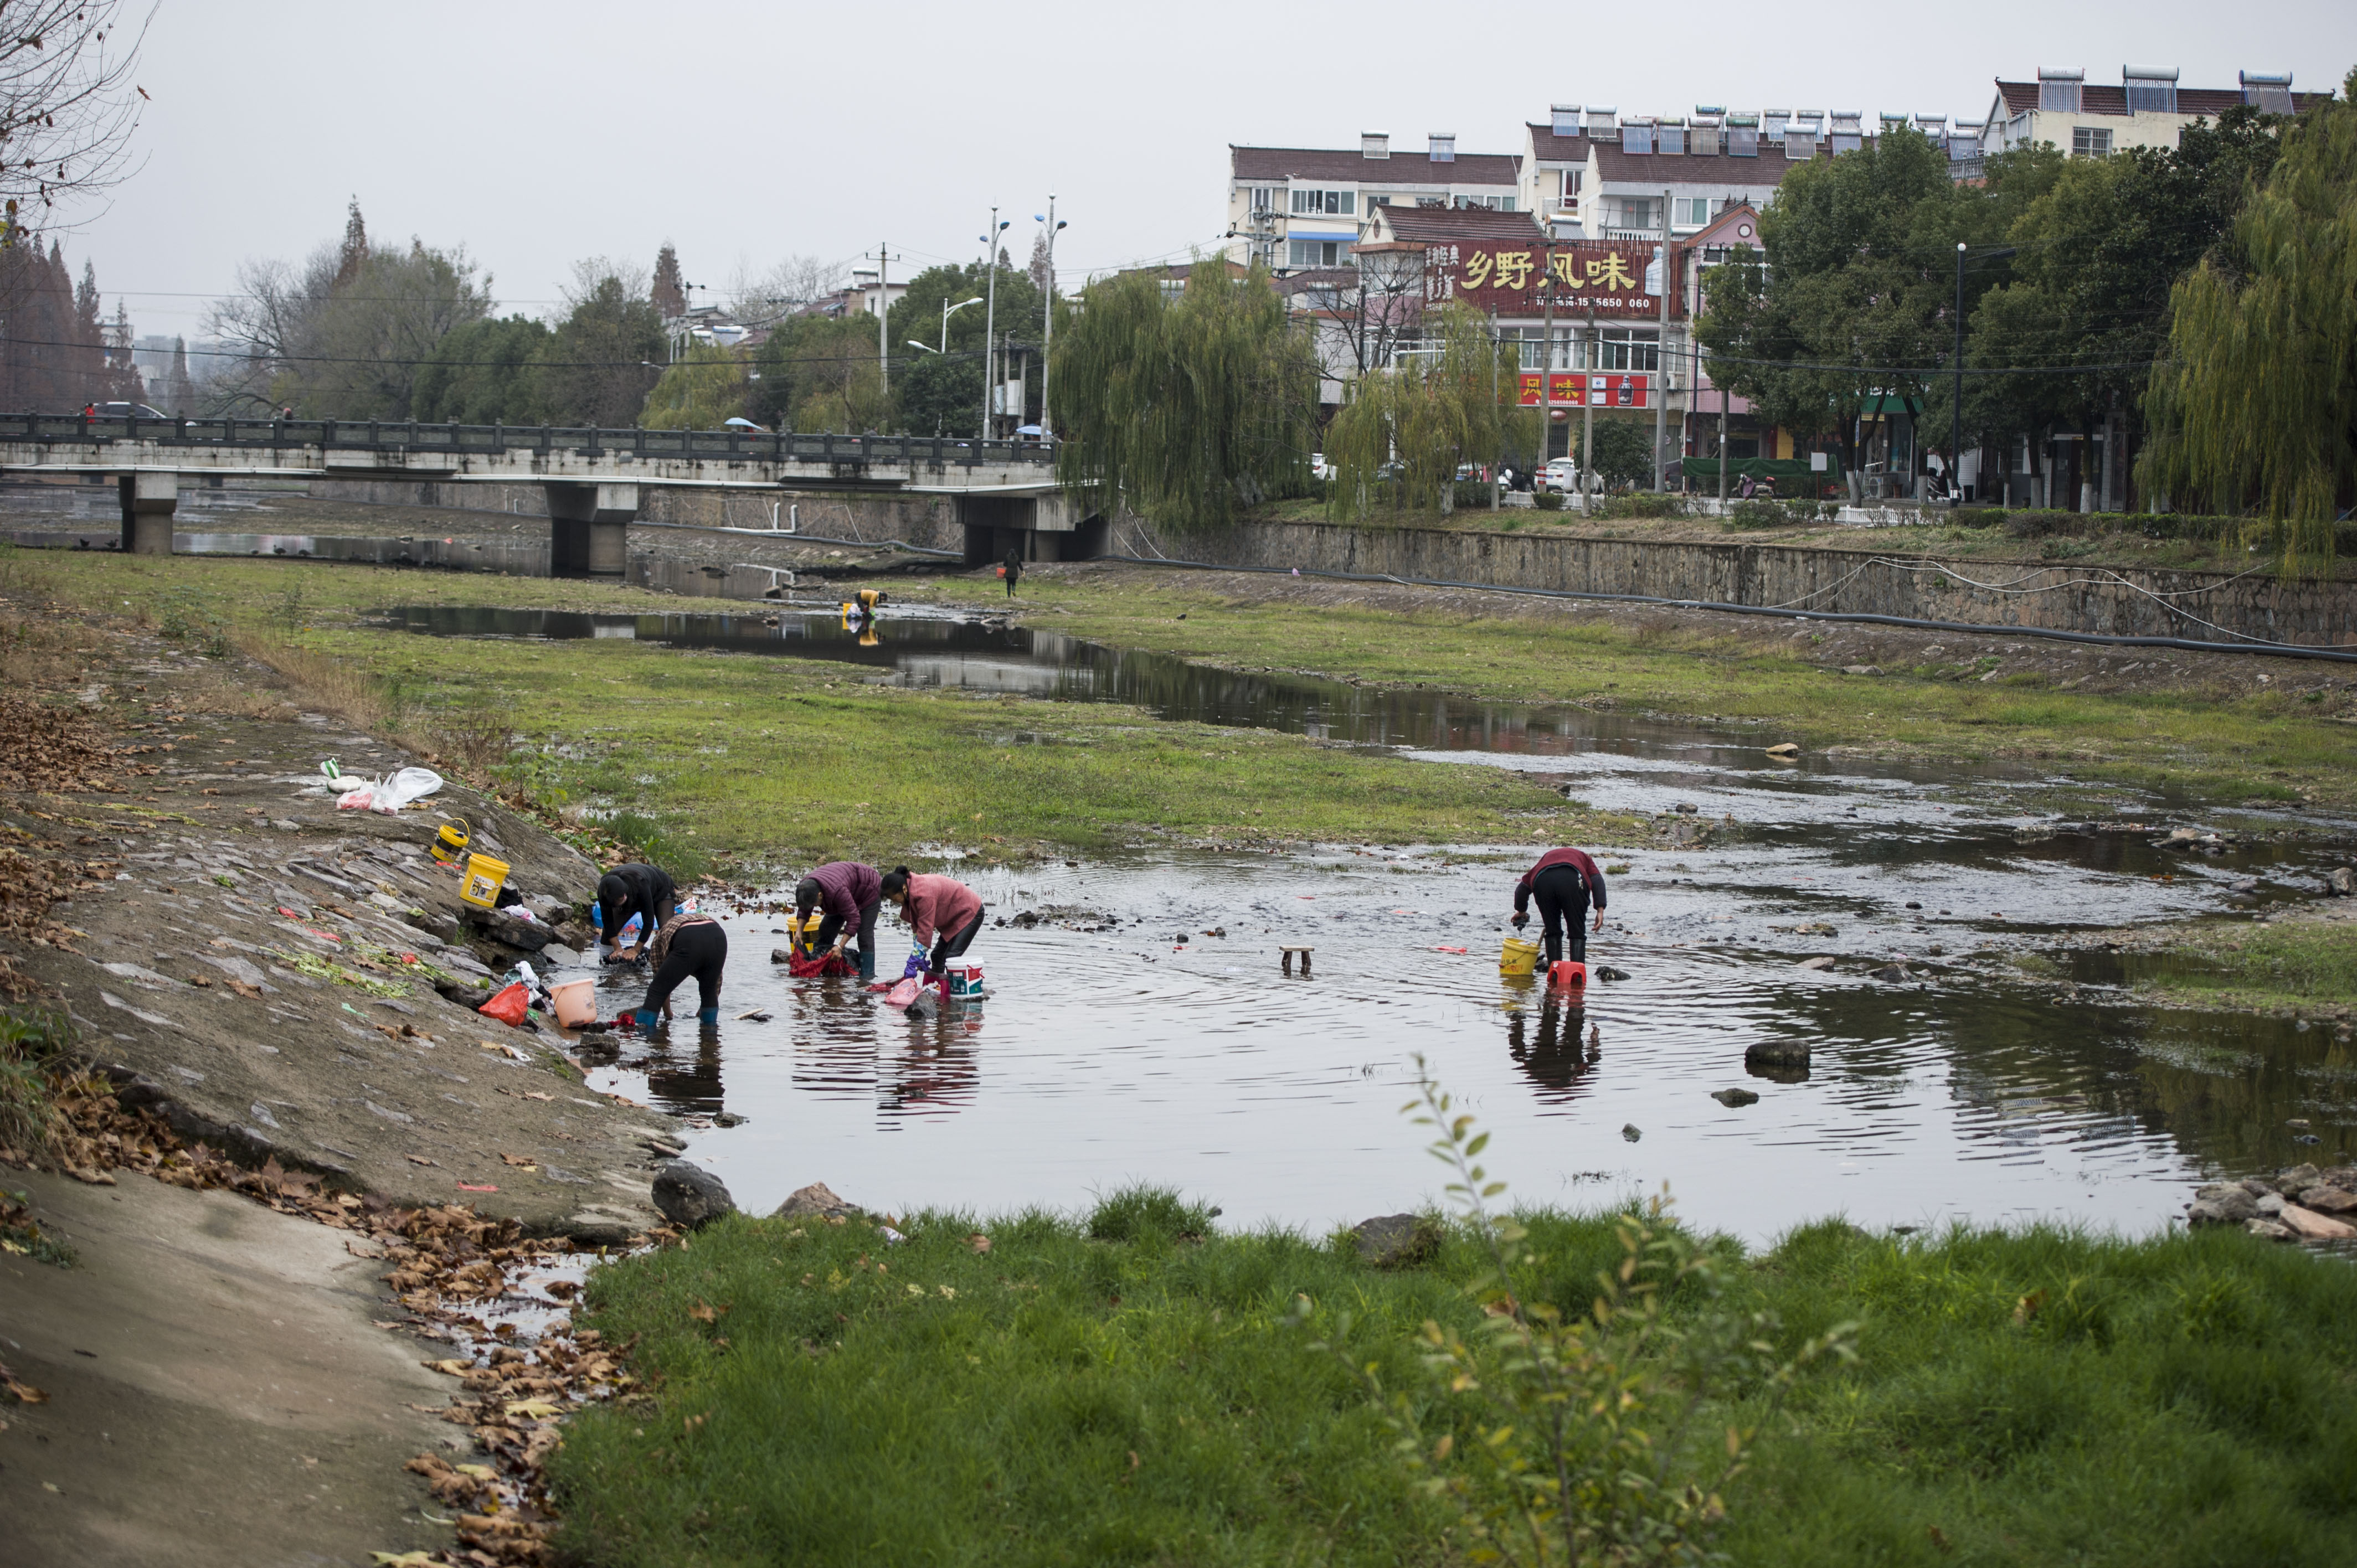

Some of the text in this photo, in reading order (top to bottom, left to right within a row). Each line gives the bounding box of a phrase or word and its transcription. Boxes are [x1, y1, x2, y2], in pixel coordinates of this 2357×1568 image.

[1460, 250, 1636, 292] 乡野风味
[1523, 378, 1579, 400] 风味
